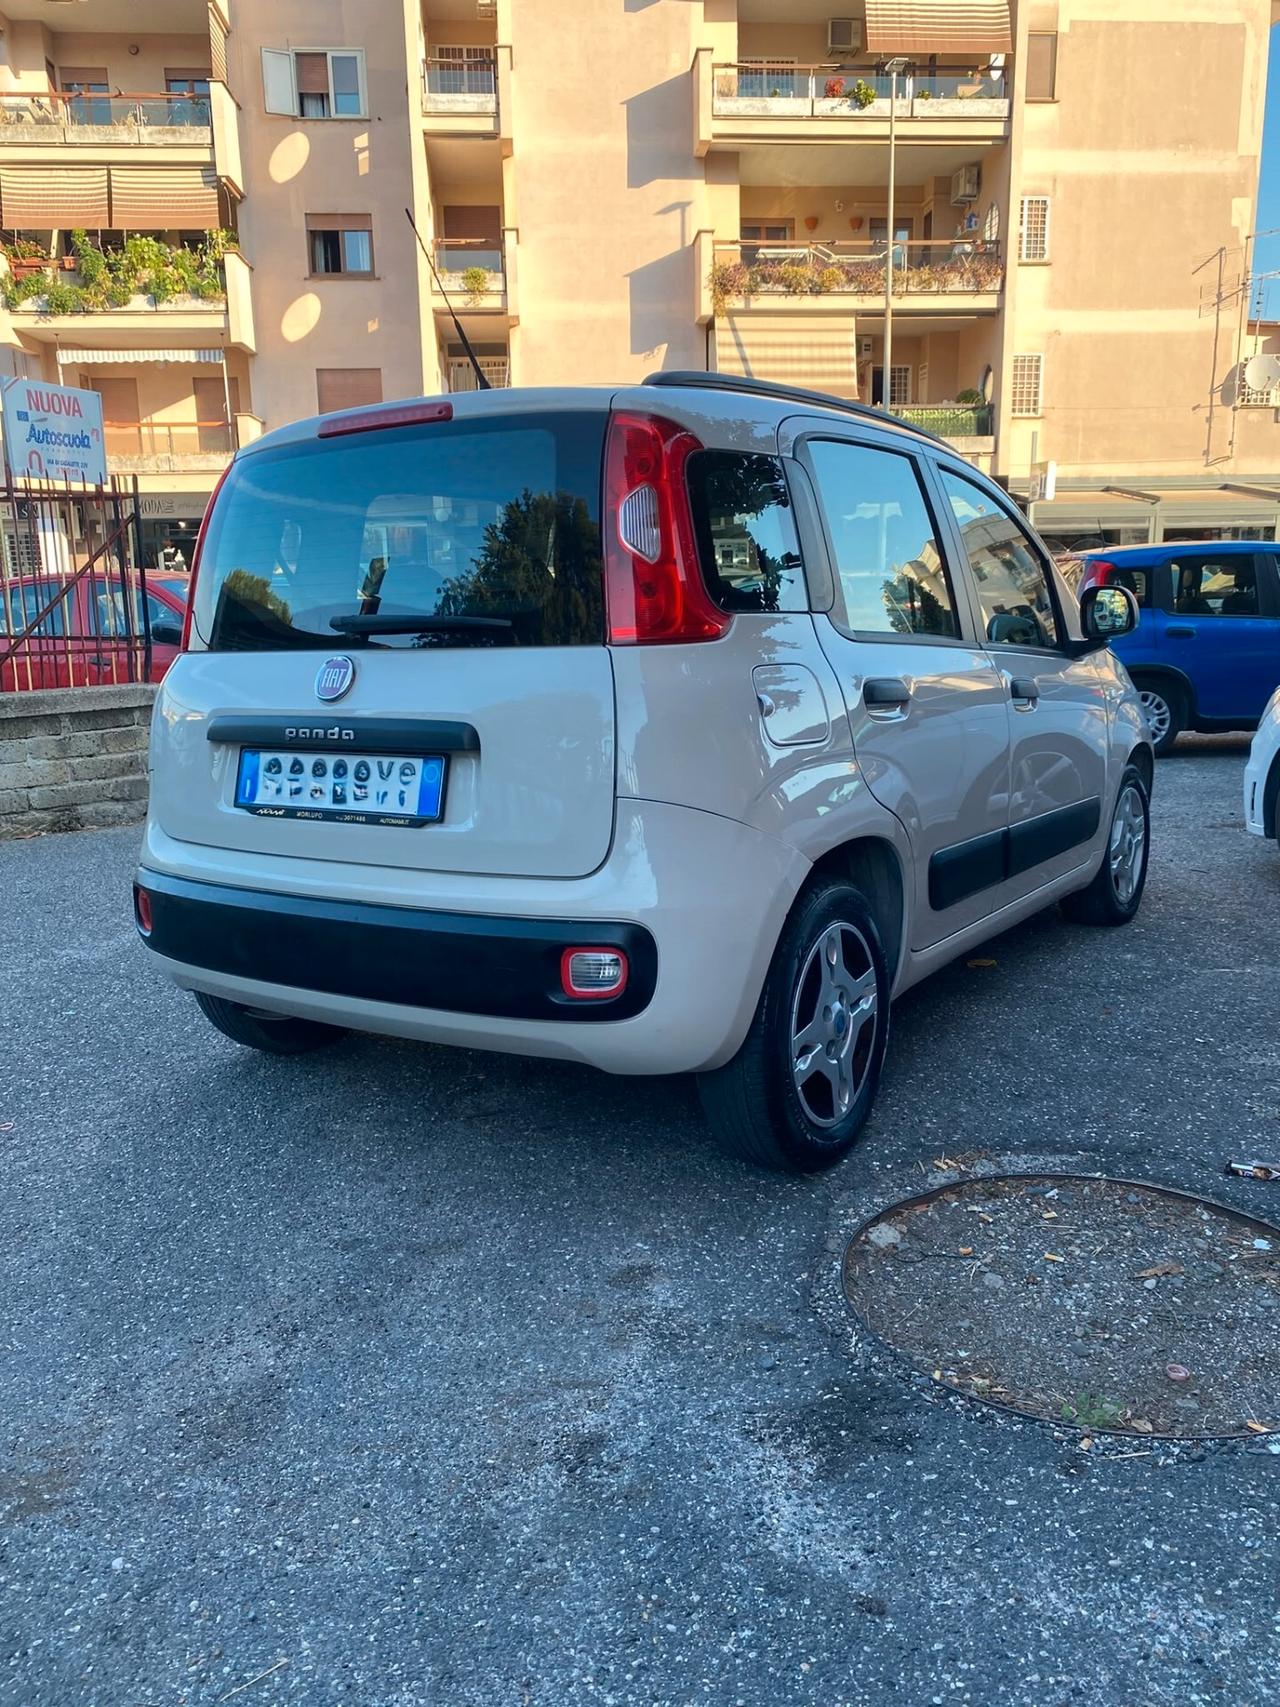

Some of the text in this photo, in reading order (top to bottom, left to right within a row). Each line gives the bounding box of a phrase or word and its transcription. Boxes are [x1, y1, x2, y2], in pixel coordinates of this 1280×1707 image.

[26, 389, 83, 418] NUOVA
[25, 423, 91, 449] Autoscuola
[321, 668, 347, 688] FIAT
[285, 727, 354, 740] panda
